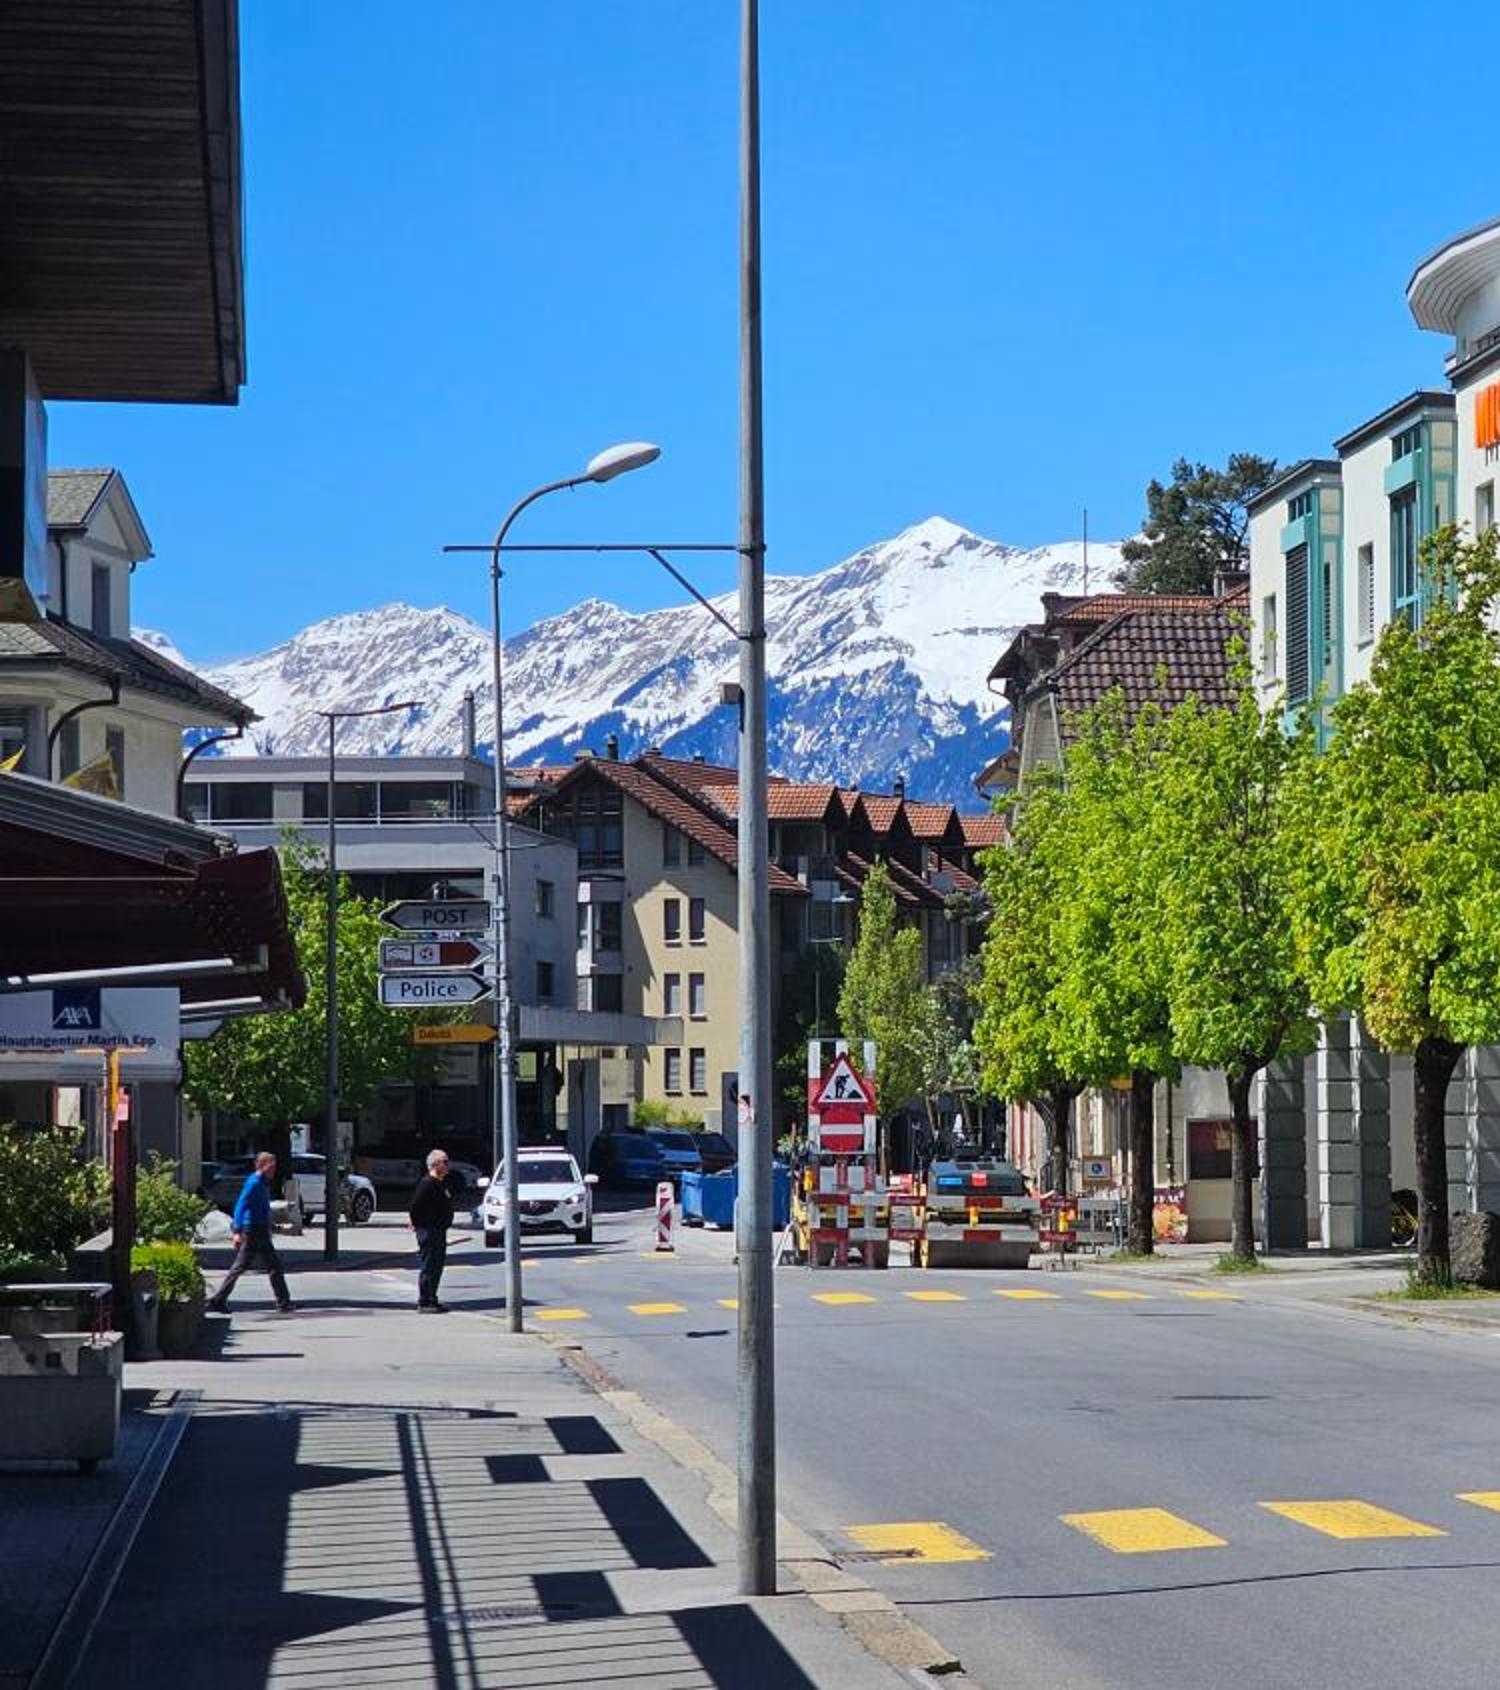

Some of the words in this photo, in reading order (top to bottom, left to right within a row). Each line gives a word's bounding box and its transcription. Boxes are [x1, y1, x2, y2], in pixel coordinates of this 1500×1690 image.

[422, 909, 469, 924] POST
[401, 981, 458, 997] Police
[54, 1007, 93, 1025] AXA
[88, 1033, 129, 1046] Martin
